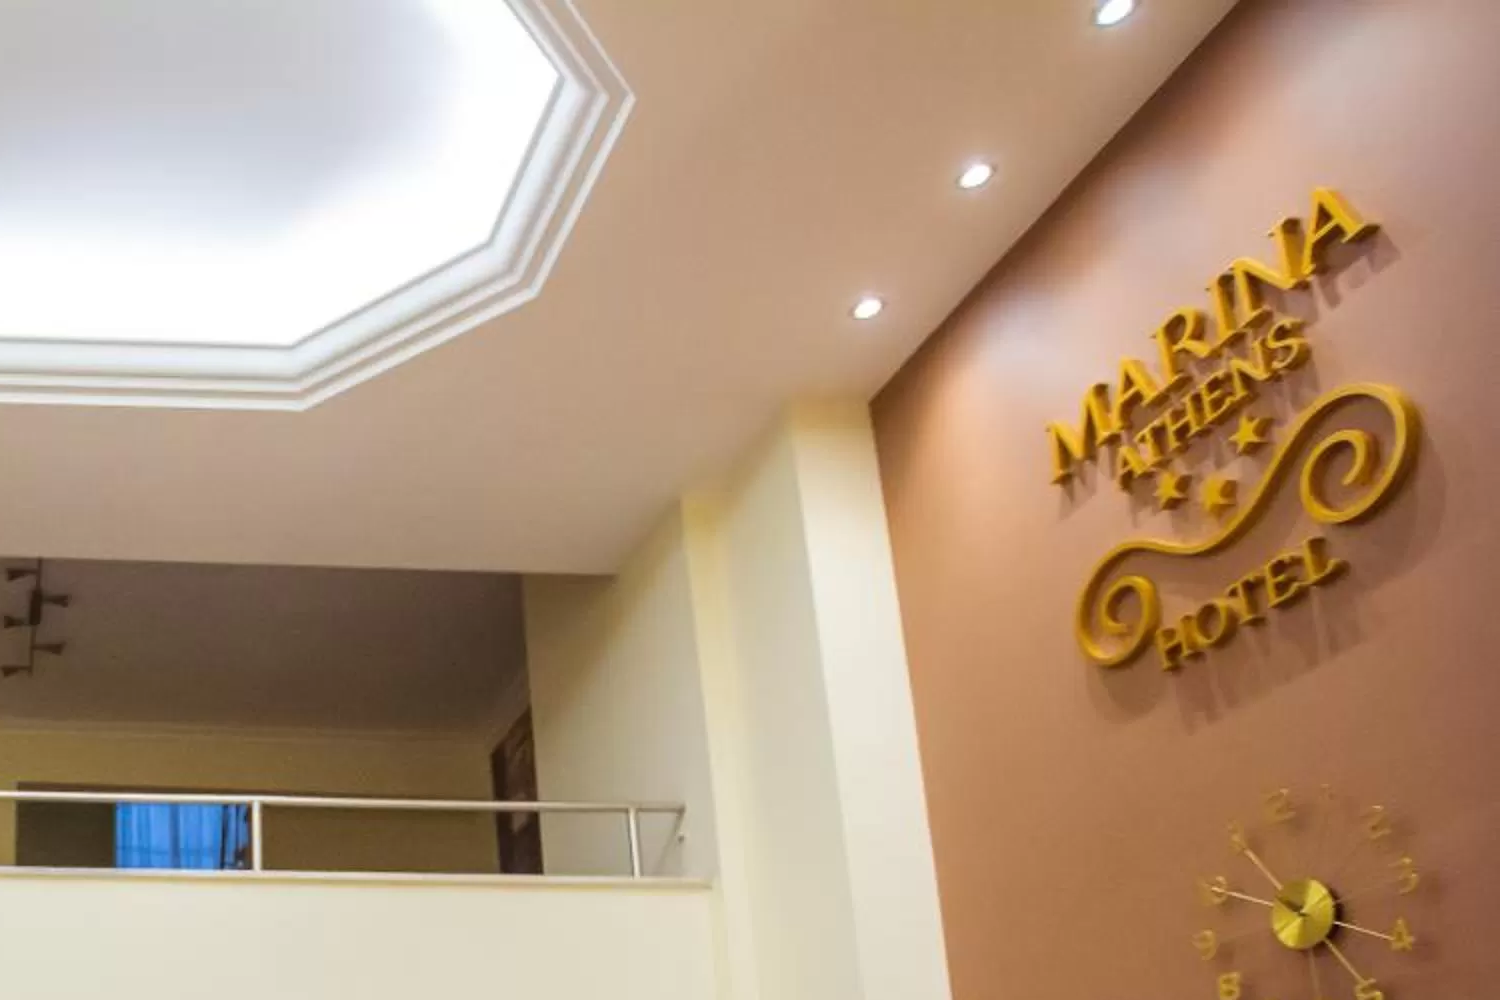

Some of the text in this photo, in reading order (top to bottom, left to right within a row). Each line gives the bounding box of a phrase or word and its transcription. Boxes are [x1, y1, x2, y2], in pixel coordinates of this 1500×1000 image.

[1046, 186, 1382, 485] MARINA
[1117, 317, 1311, 491] ATHENS
[1154, 536, 1350, 672] HOTEL
[1390, 917, 1415, 951] 4
